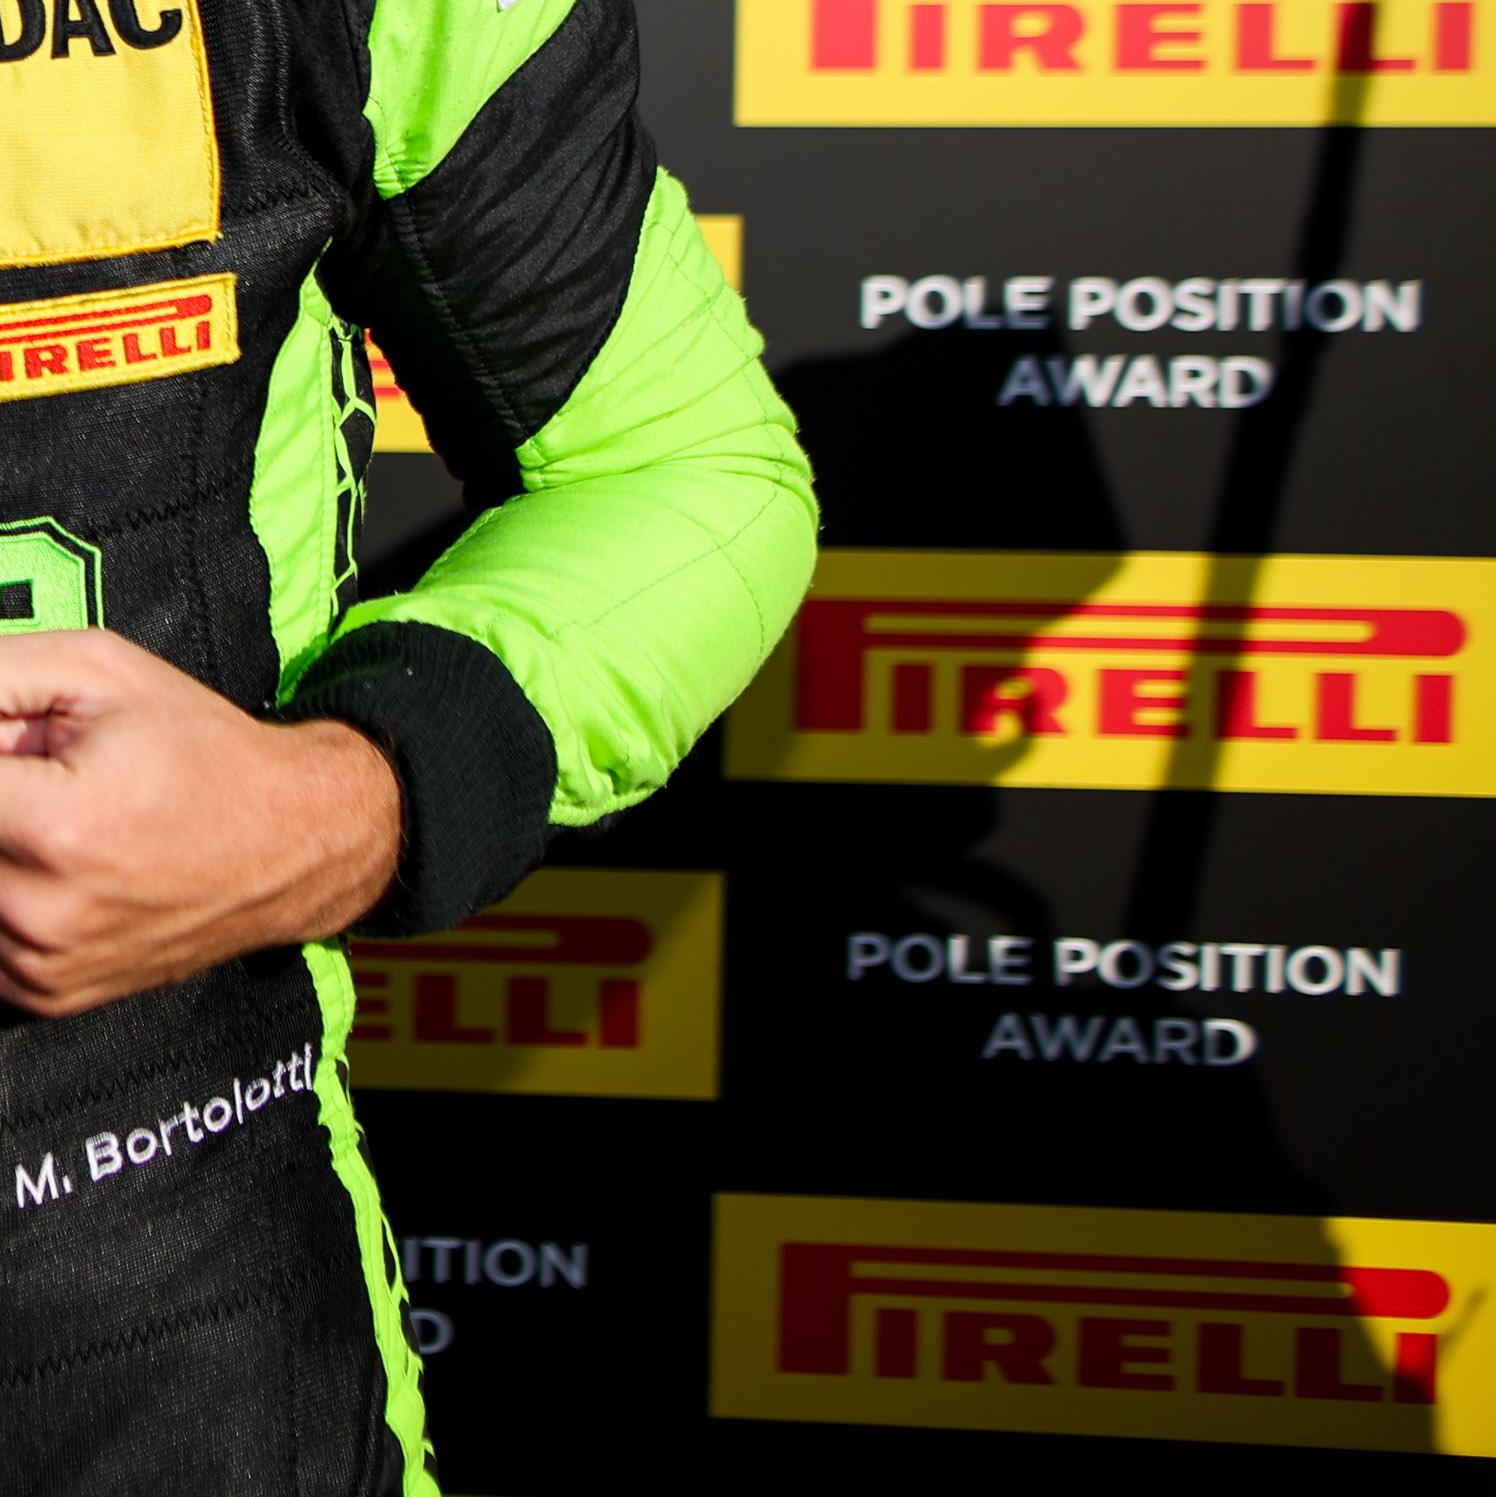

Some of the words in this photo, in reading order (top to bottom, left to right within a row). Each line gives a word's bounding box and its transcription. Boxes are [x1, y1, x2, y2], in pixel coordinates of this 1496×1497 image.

[860, 274, 1053, 330] POLE
[1070, 276, 1421, 333] POSITION
[998, 353, 1274, 409] AWARD
[793, 597, 1468, 745] PIRELLI
[849, 933, 1031, 984] POLE
[1055, 937, 1403, 998] POSITION
[983, 1014, 1258, 1066] AWARD
[15, 1152, 74, 1209] M.
[398, 1237, 588, 1289] ITION
[778, 1241, 1452, 1406] PIRELLI
